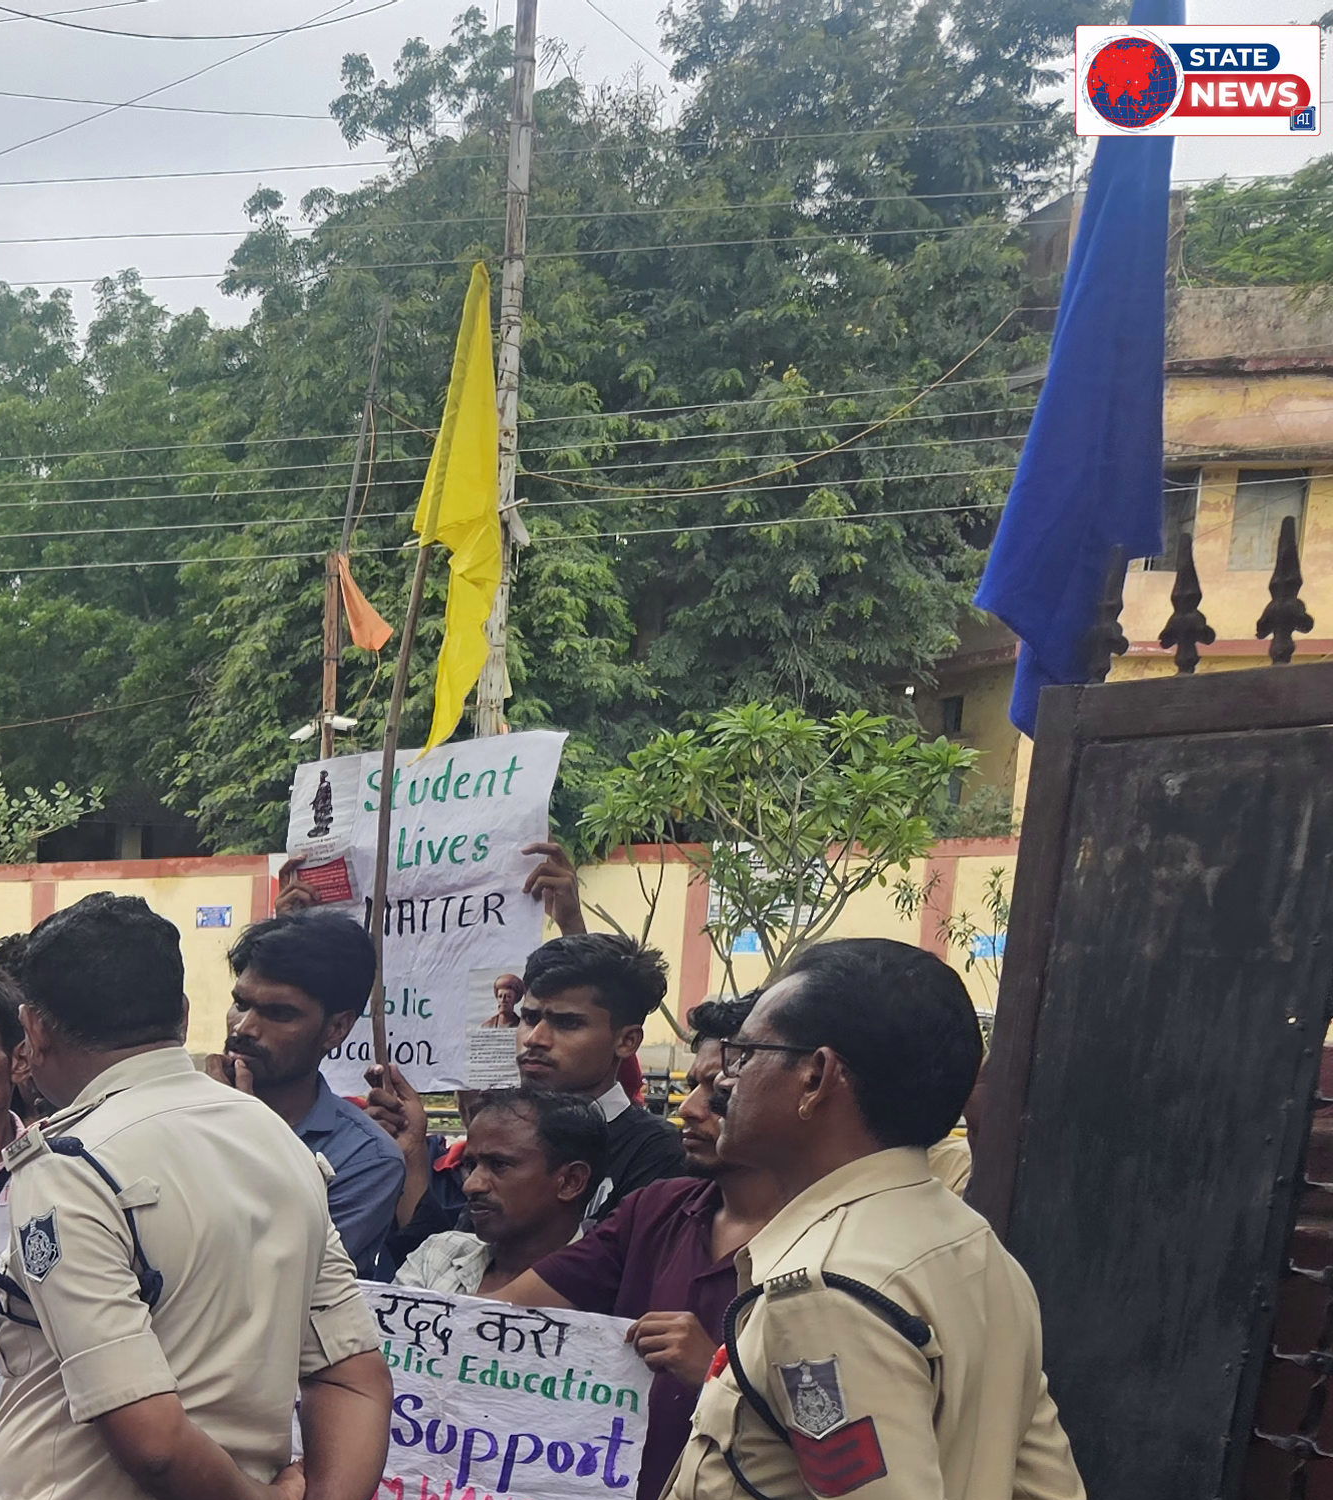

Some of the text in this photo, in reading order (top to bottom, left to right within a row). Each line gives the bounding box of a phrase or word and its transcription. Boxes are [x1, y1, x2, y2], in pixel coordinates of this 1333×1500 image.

[364, 755, 524, 812] Student
[396, 827, 490, 872] Lives
[364, 892, 506, 937] MATTER
[361, 986, 433, 1020] blic
[475, 1306, 571, 1358] करो
[382, 1340, 640, 1414] blic Education
[390, 1393, 634, 1494] Support
